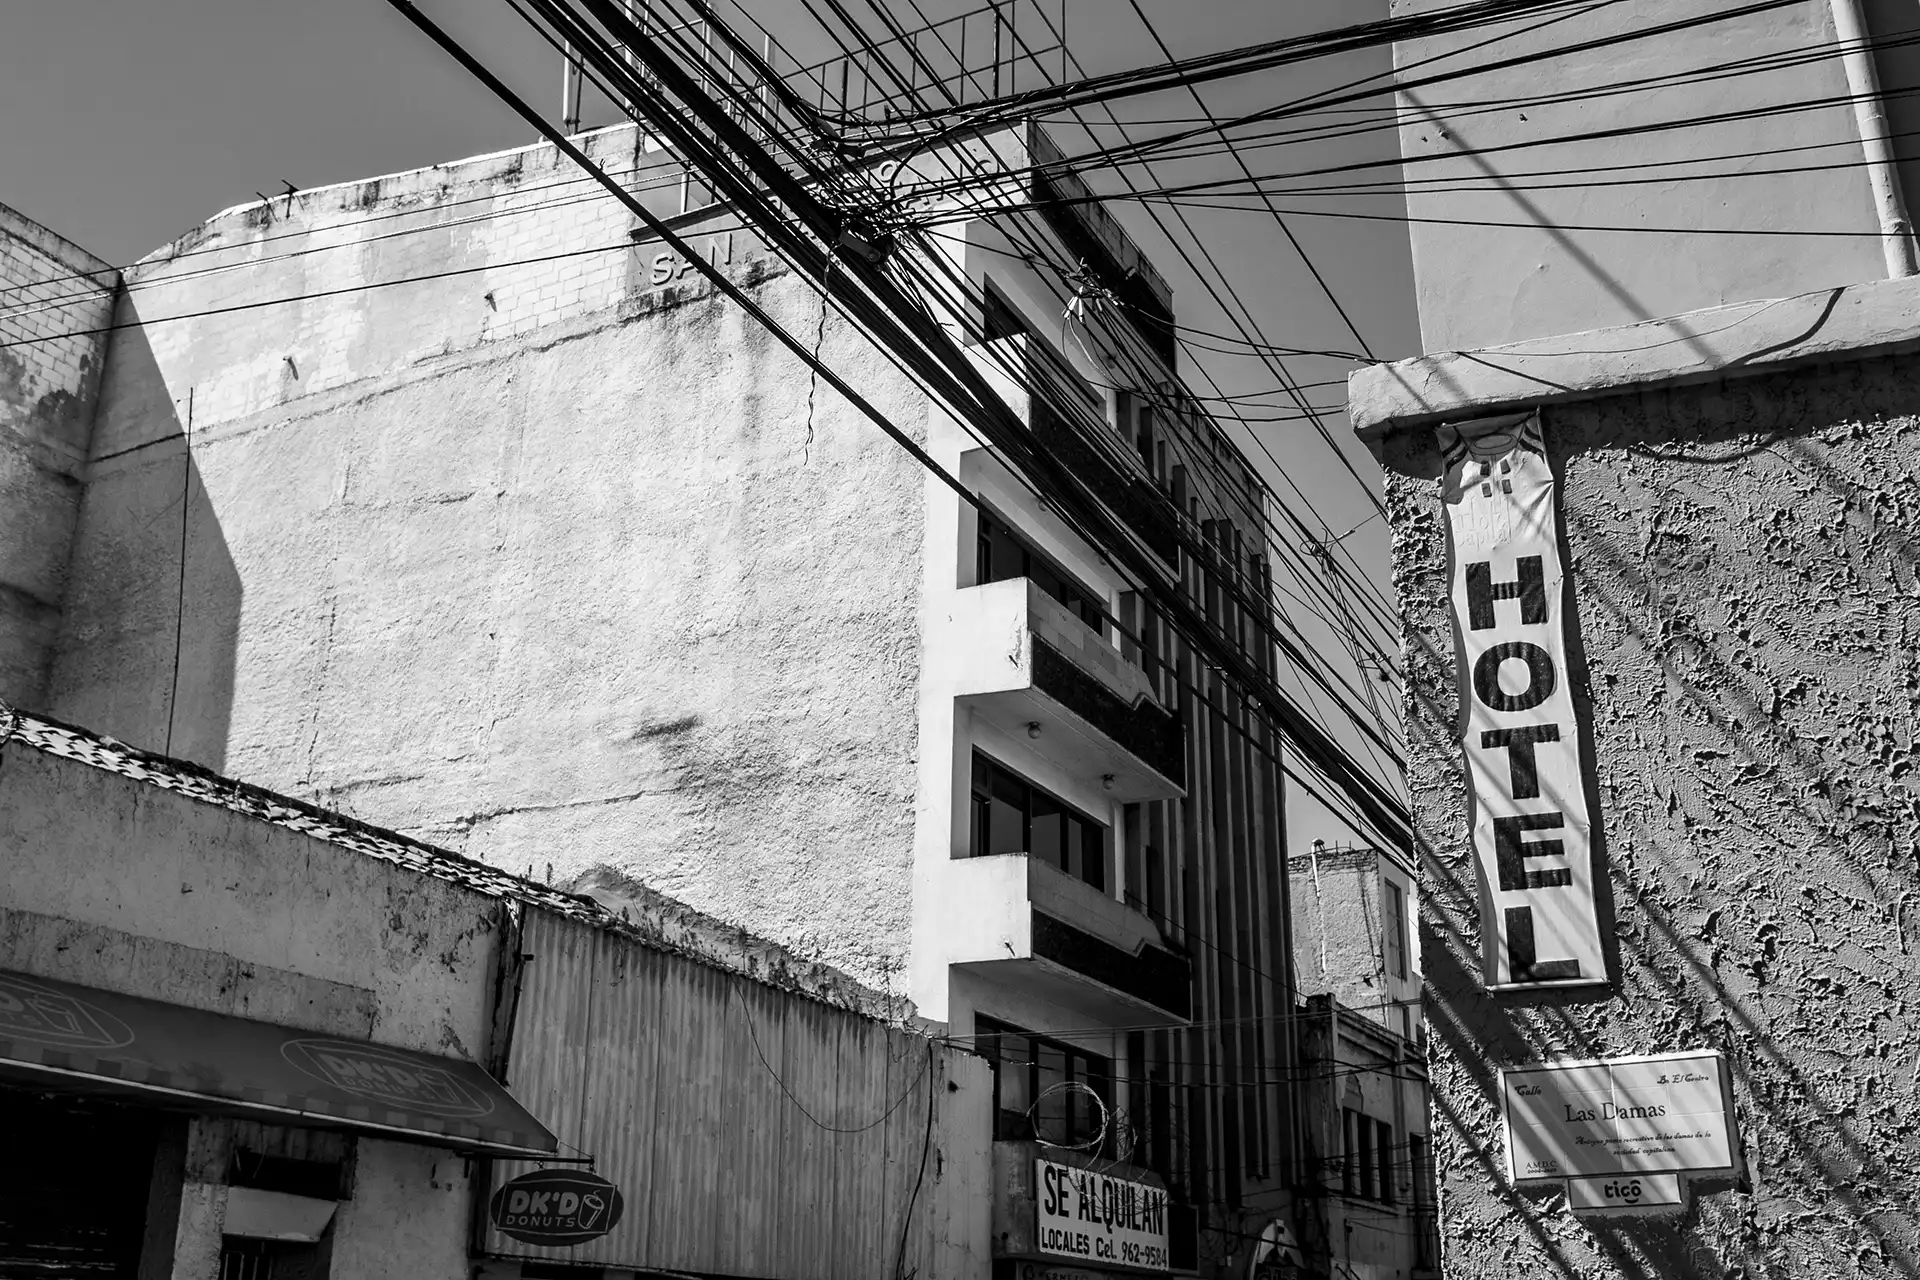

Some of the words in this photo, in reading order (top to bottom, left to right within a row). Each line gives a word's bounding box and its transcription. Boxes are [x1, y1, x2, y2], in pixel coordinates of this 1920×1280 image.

[1465, 554, 1582, 983] HOTEL
[318, 1053, 420, 1088] DK'D
[1514, 1084, 1542, 1097] Calle
[1564, 1104, 1596, 1122] Las
[1602, 1101, 1666, 1120] Damas
[508, 1190, 579, 1215] DK'D
[1044, 1164, 1069, 1218] SE
[1078, 1174, 1164, 1236] ALQUILAN
[506, 1215, 576, 1228] DONUTS
[1041, 1226, 1090, 1255] LOCALES
[1096, 1237, 1118, 1259] Cel.
[1121, 1241, 1167, 1267] 962-9584
